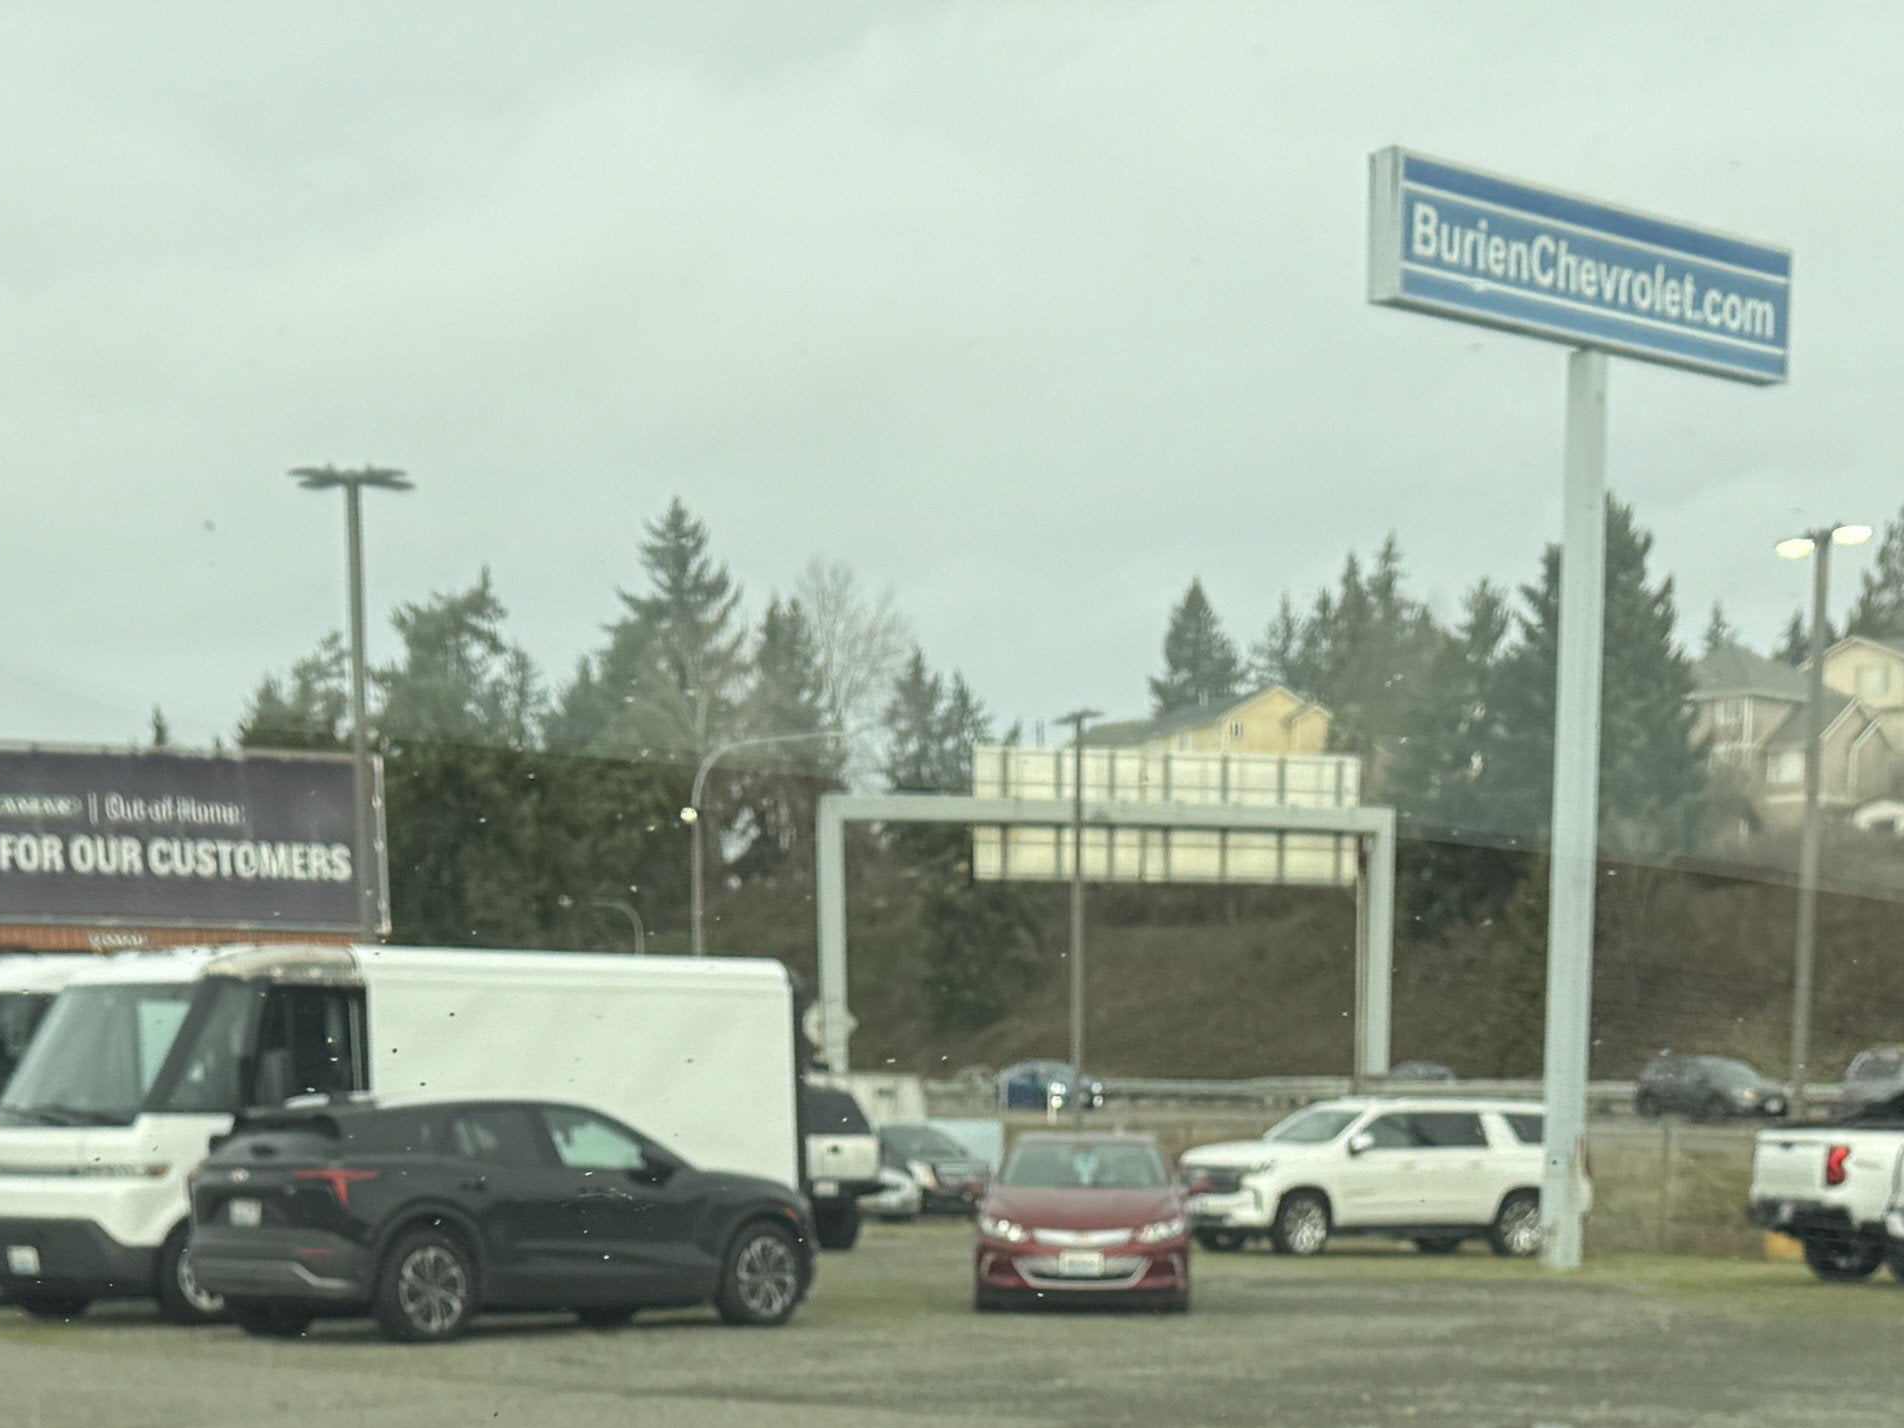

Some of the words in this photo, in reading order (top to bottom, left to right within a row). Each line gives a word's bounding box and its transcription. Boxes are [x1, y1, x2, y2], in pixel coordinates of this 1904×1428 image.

[1412, 203, 1775, 338] BurienChevrolet.com
[69, 836, 142, 876] OUR
[148, 840, 353, 882] CUSTOMERS
